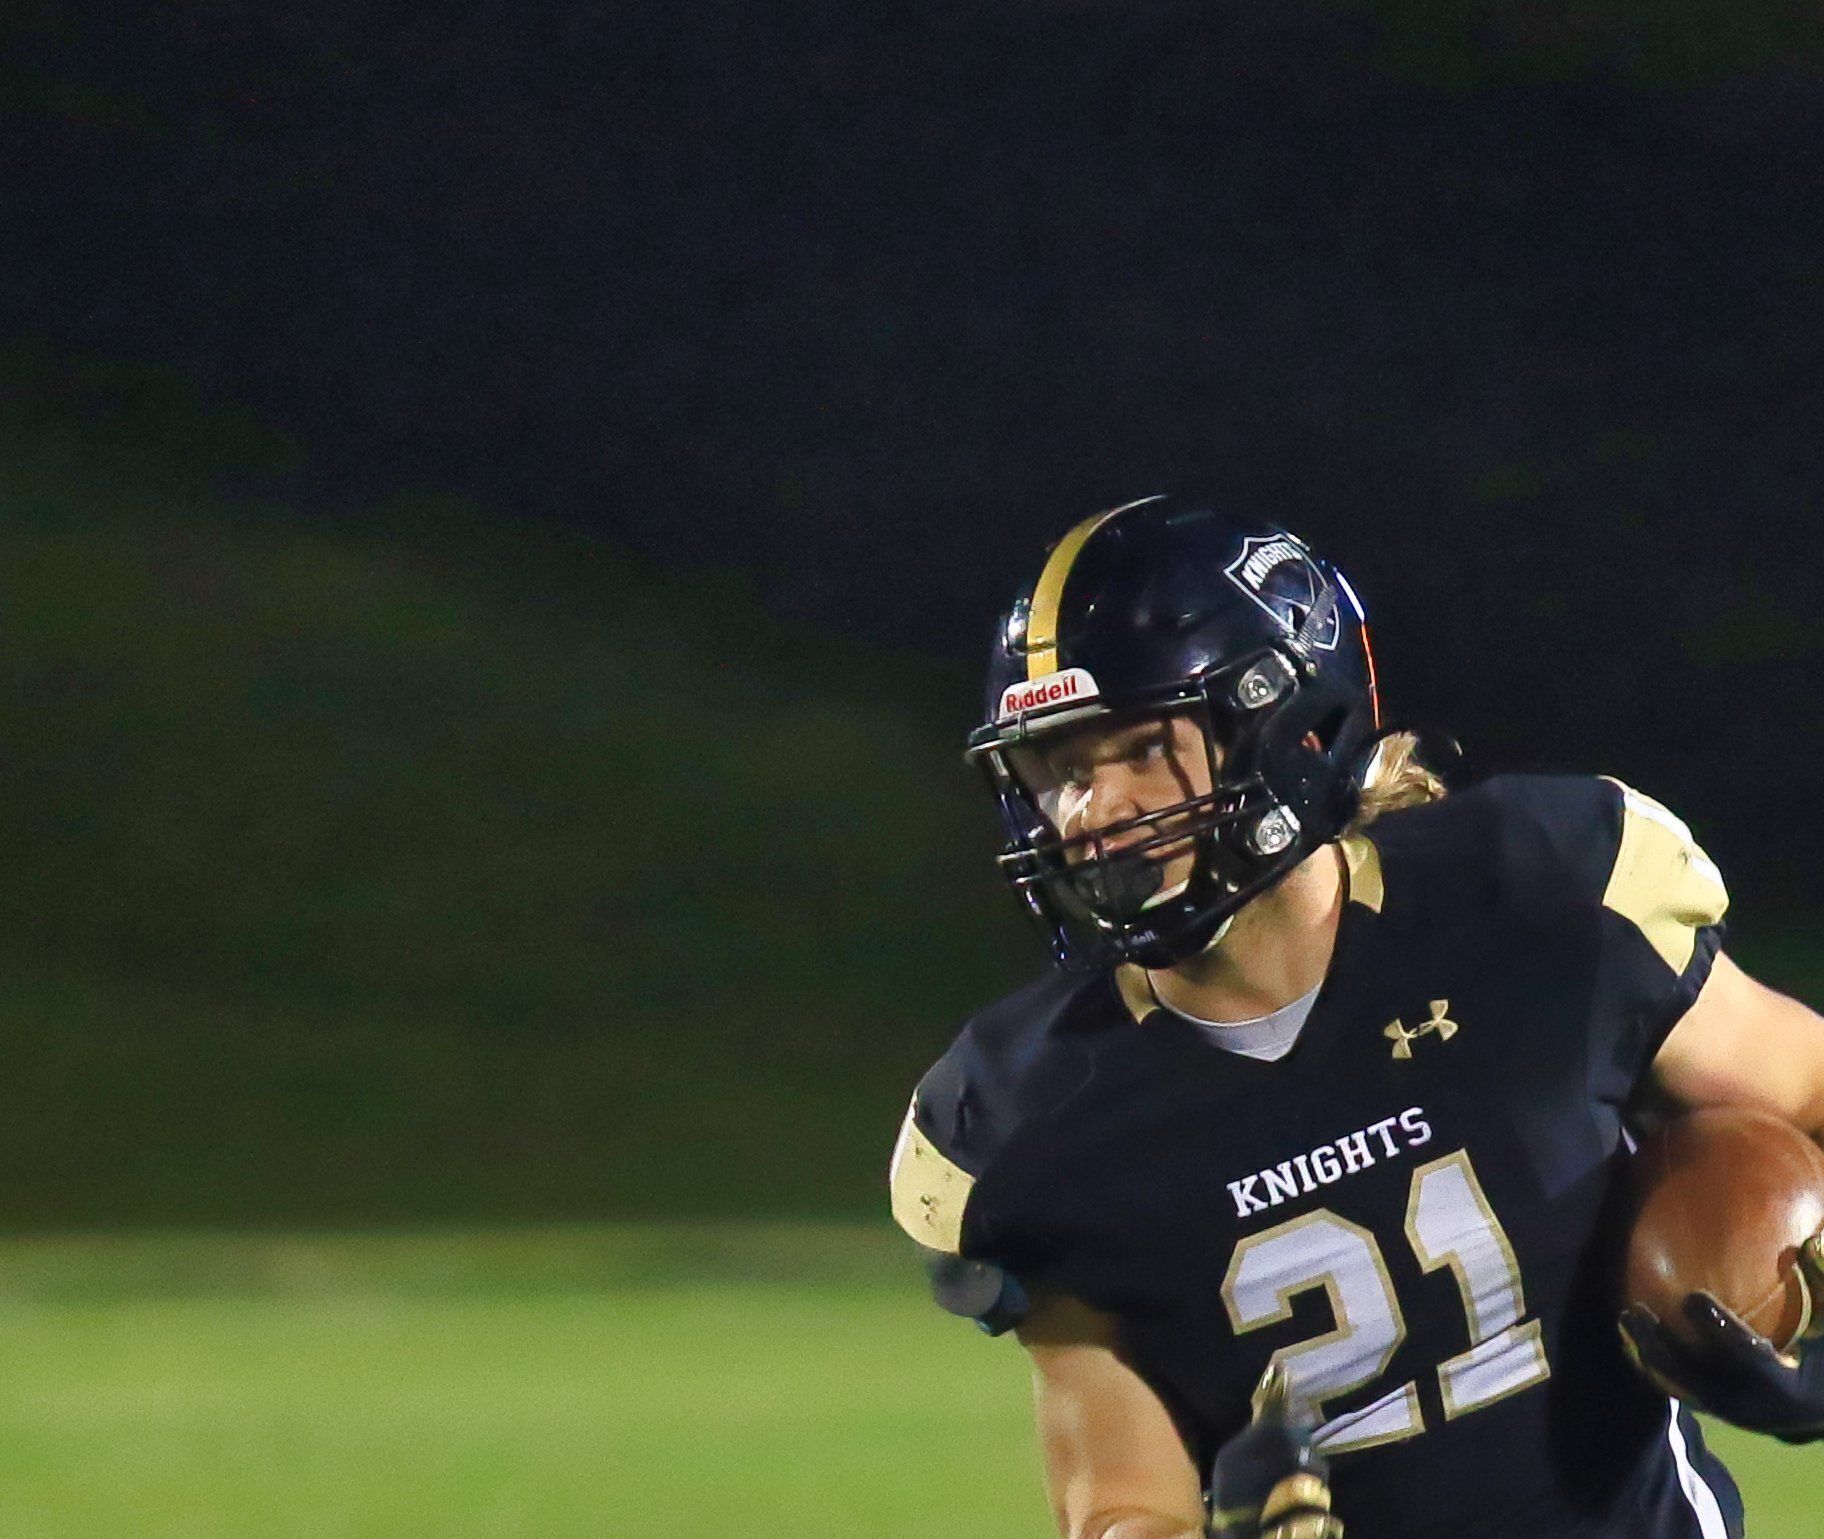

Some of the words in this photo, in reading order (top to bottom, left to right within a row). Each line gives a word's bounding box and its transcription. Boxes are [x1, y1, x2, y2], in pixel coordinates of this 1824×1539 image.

[1005, 675, 1078, 713] Riddell
[1226, 1106, 1432, 1218] KNIGHTS
[1219, 1148, 1552, 1455] 21
